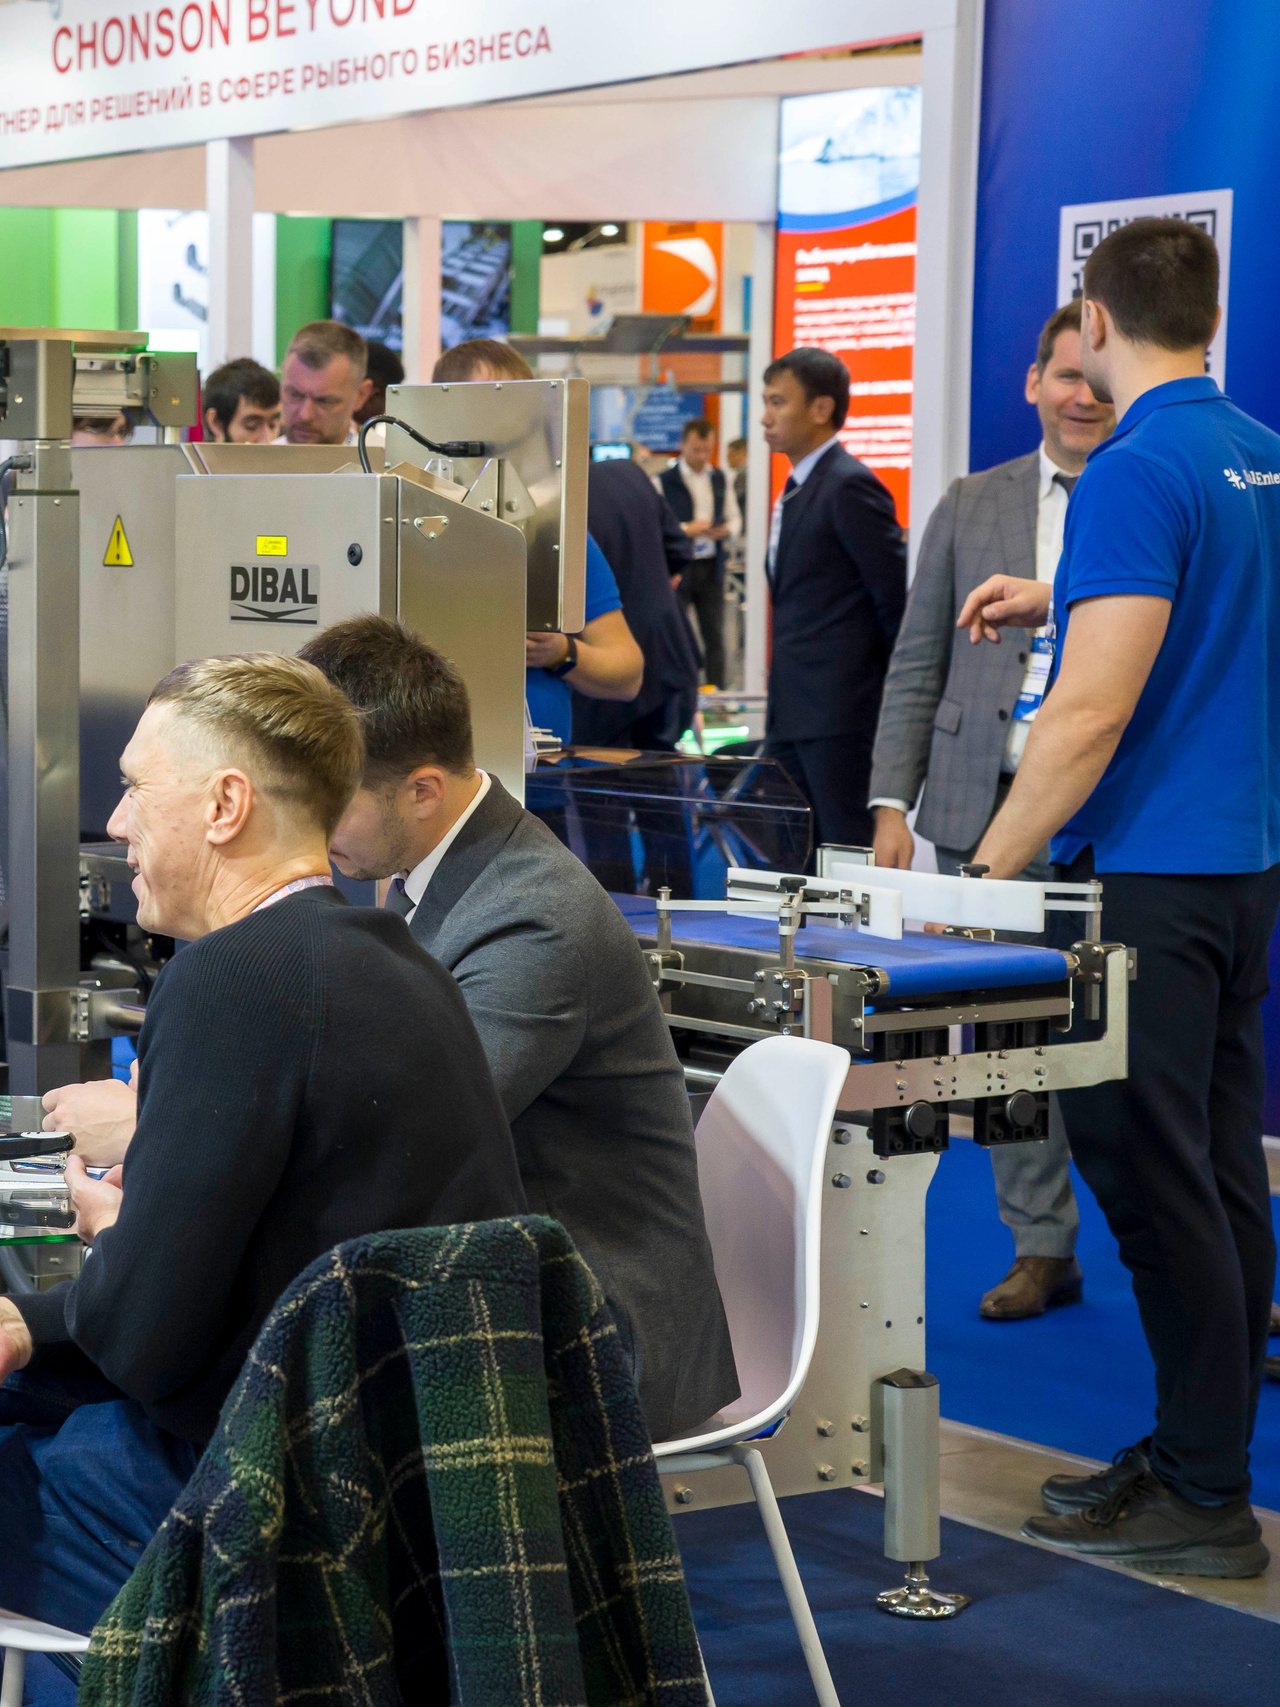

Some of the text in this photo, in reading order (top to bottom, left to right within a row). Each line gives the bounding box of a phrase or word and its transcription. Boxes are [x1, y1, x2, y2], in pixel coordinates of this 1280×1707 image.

[52, 0, 231, 74] CHONSON
[45, 100, 85, 134] ДЛЯ
[91, 76, 193, 121] РЕШЕНИЙ
[199, 81, 212, 106] В
[219, 67, 295, 103] СФЕРЕ
[301, 48, 418, 90] РЫБНОГО
[426, 25, 552, 72] БИЗНЕСА
[231, 566, 317, 604] DIBAL
